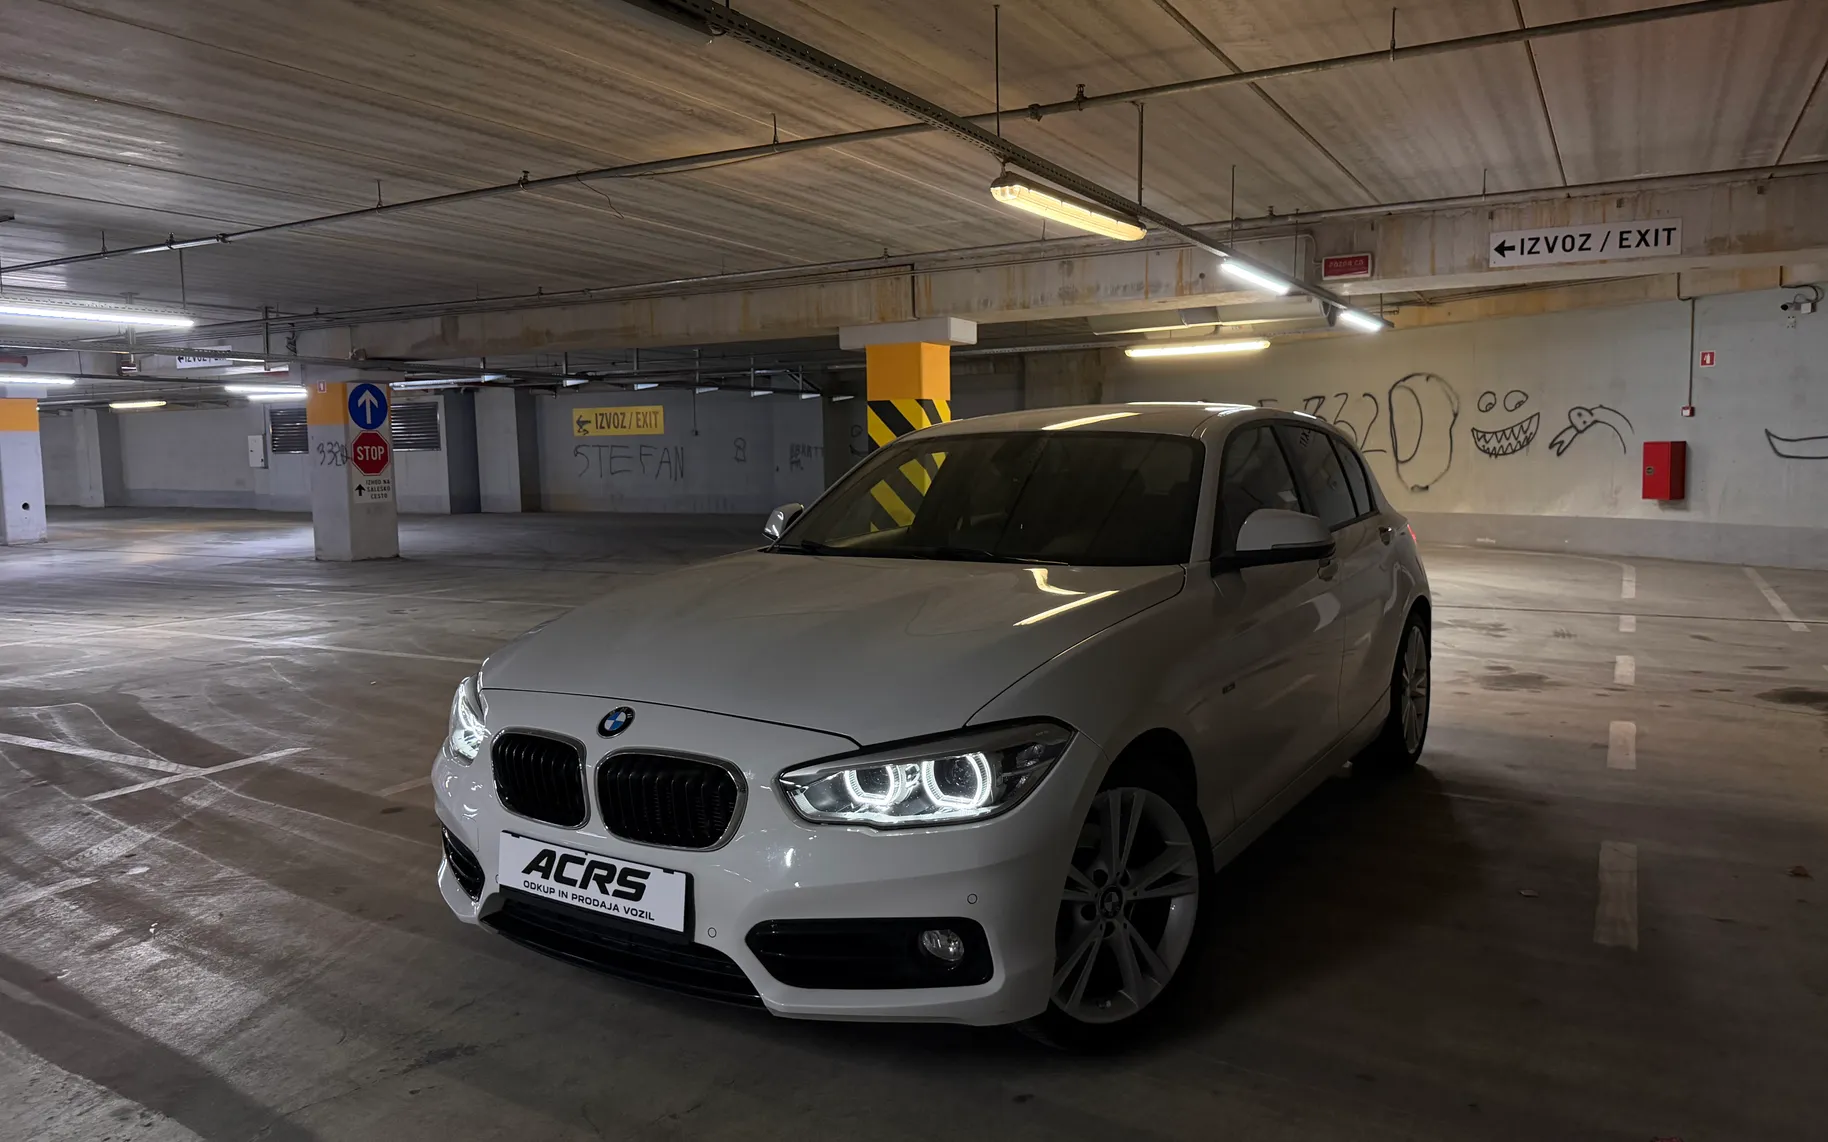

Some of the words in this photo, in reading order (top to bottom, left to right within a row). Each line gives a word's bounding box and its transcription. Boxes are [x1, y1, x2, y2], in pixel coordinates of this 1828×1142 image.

[1520, 233, 1592, 256] IZVOZ
[1619, 227, 1677, 249] EXIT
[595, 412, 626, 430] IZVOZ
[636, 411, 659, 429] EXIT
[357, 445, 385, 461] STOP
[574, 444, 684, 482] STEFAN
[521, 848, 651, 902] ACRS
[523, 879, 556, 895] ODKUP
[558, 889, 569, 899] IN
[571, 893, 620, 913] PRODAJA
[623, 905, 655, 921] VOZIL
